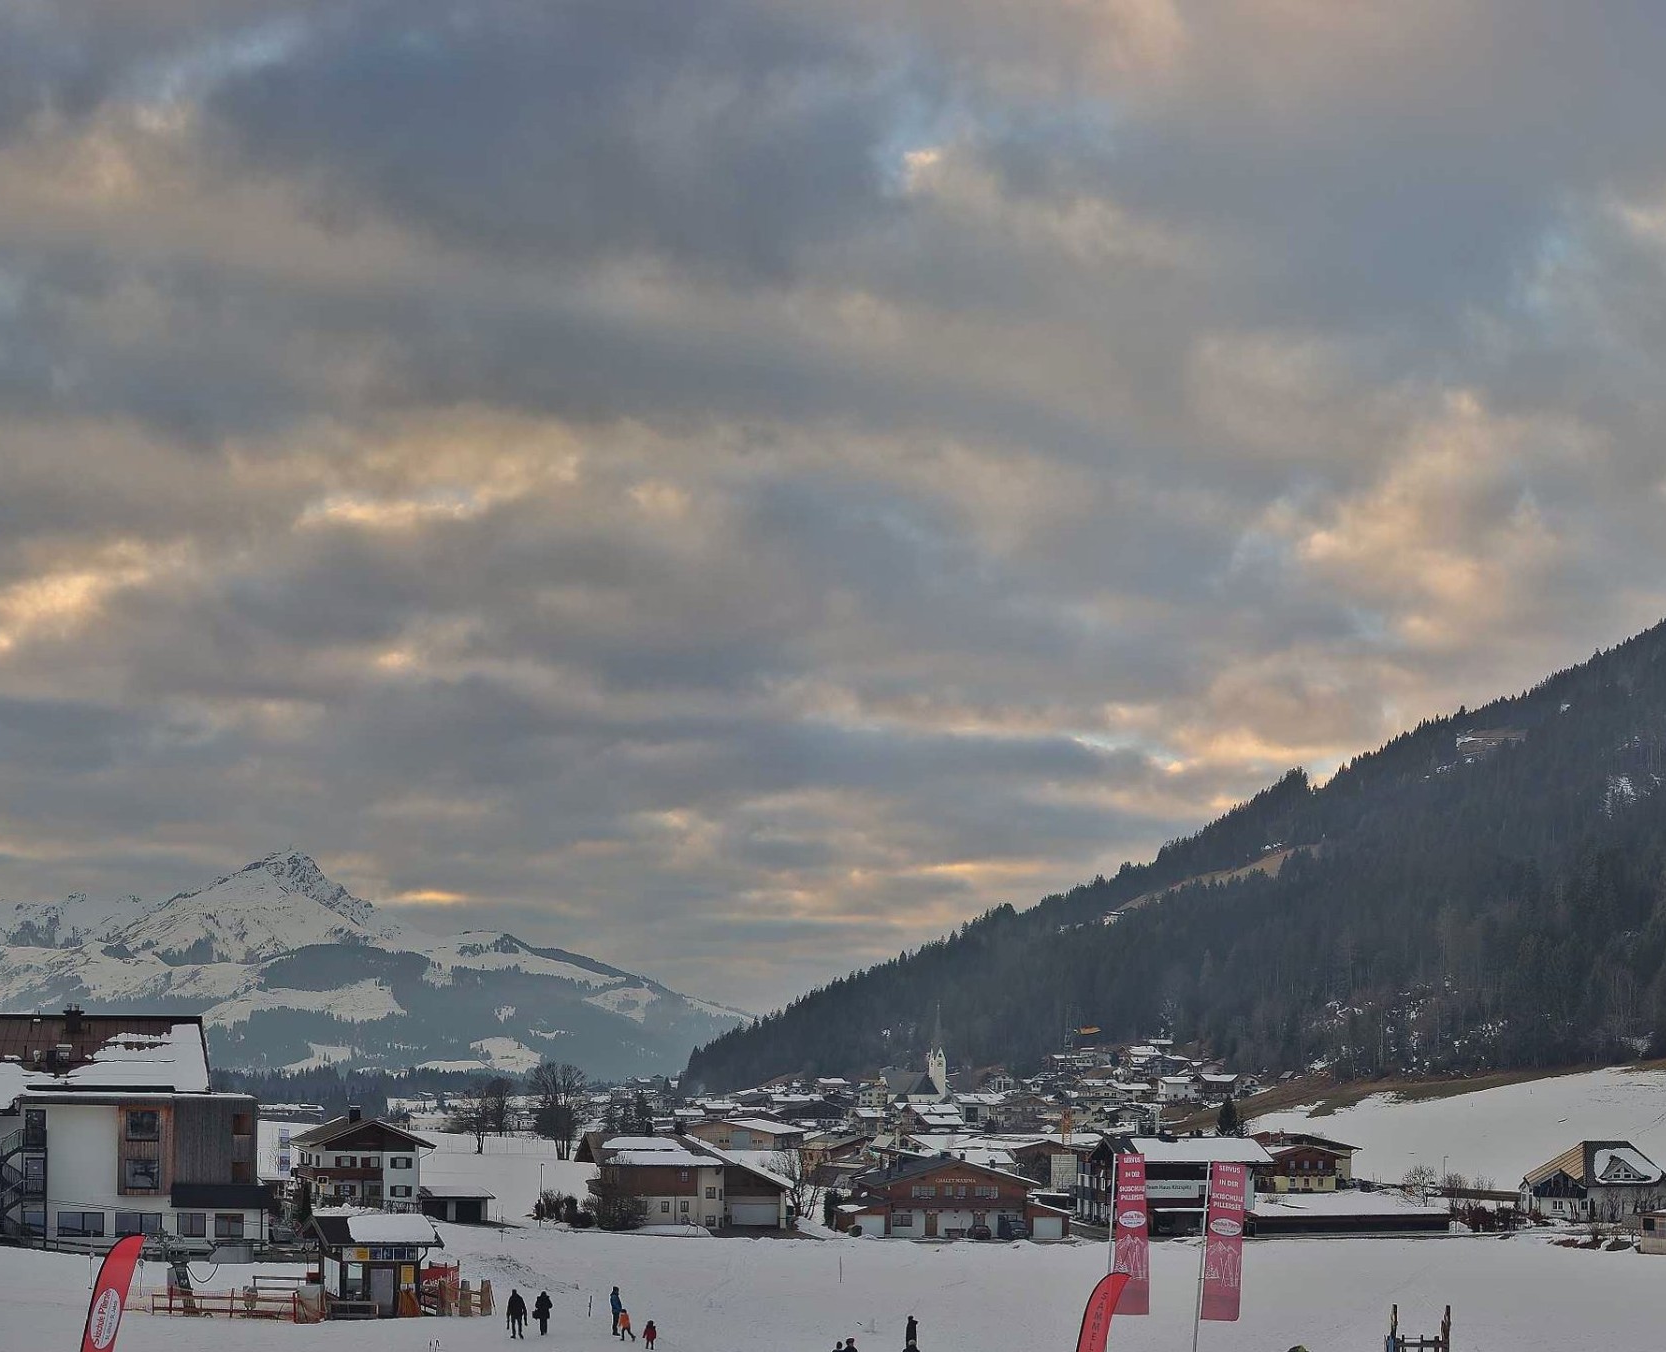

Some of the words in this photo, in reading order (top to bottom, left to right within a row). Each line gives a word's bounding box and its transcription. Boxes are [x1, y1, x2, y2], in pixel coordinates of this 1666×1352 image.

[1219, 1165, 1241, 1174] SERVUS
[1227, 1180, 1239, 1188] DER
[1212, 1192, 1243, 1203] SKISCHULE
[1213, 1201, 1242, 1211] PILLERSEE
[98, 1289, 112, 1315] Pillersee
[93, 1315, 106, 1346] Skischule
